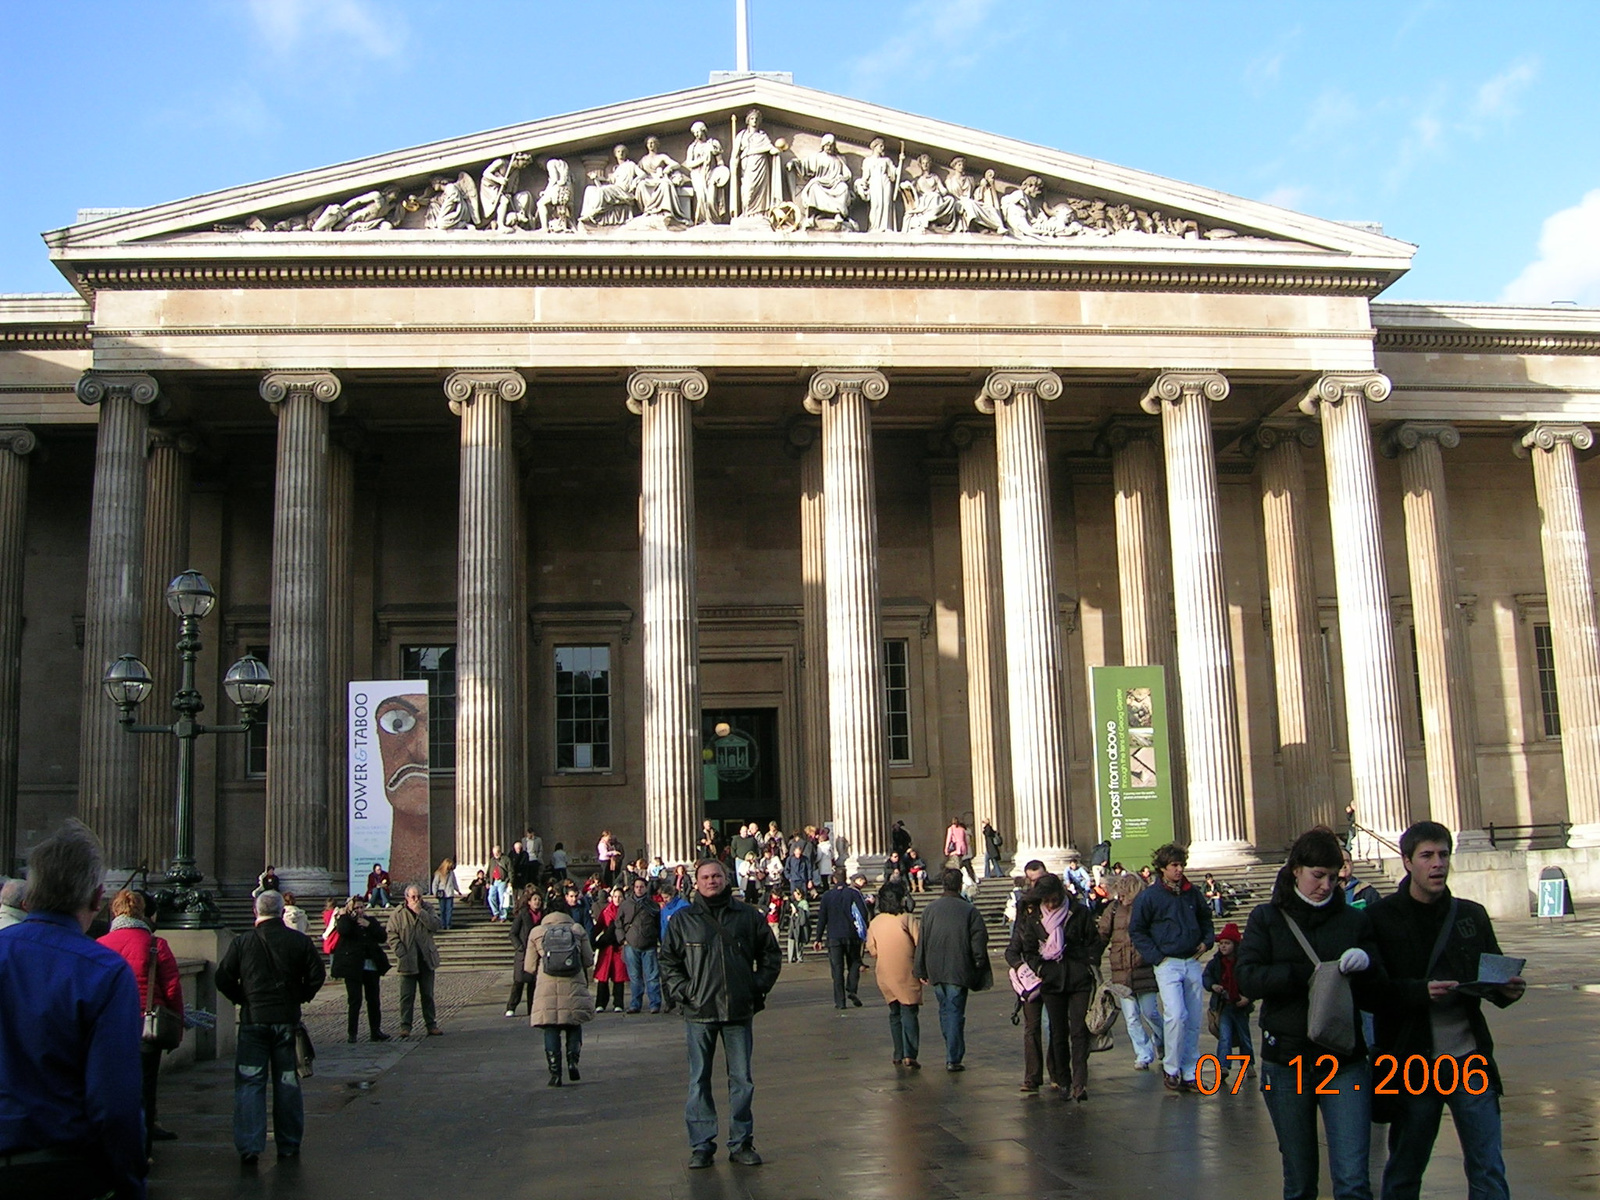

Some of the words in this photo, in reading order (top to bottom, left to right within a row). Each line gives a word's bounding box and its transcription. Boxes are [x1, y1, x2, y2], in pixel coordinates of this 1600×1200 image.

[354, 692, 368, 749] TABOO
[1106, 720, 1118, 761] above
[354, 763, 368, 820] POWER
[1107, 761, 1120, 789] from
[1108, 790, 1123, 818] past
[1110, 818, 1122, 840] the
